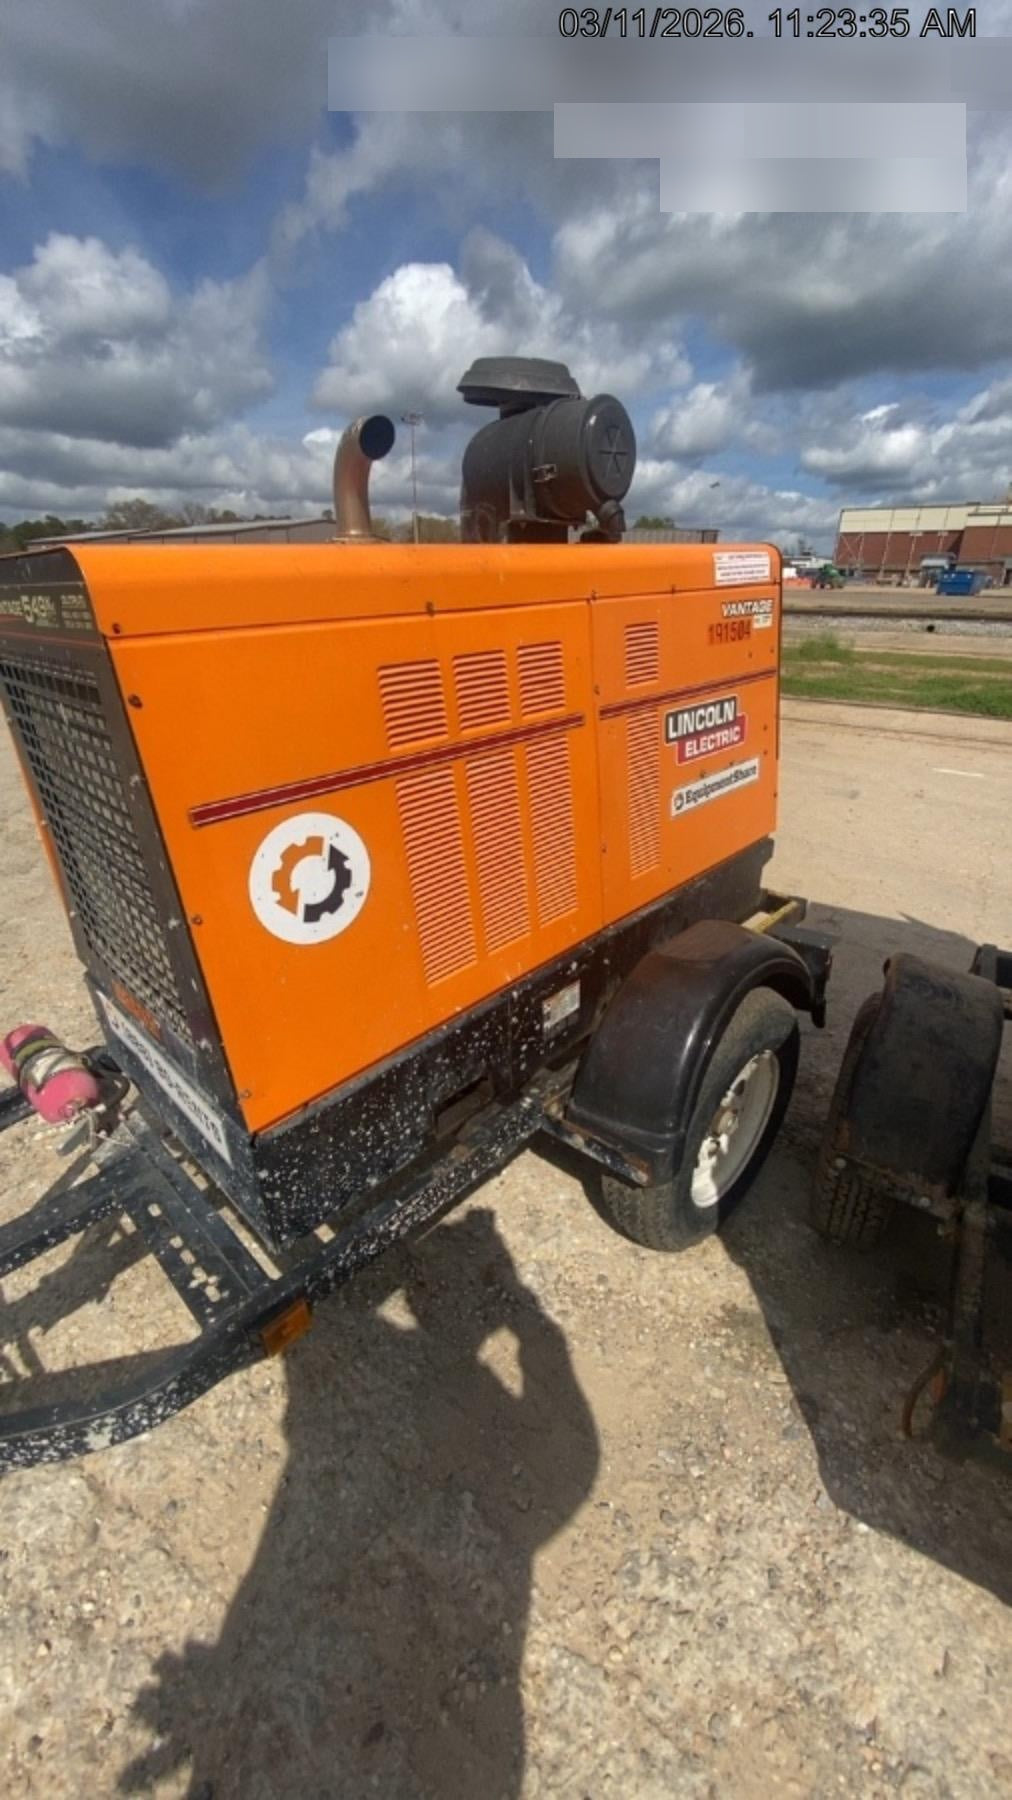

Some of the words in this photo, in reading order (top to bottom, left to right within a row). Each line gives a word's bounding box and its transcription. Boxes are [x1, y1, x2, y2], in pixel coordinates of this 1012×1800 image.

[721, 599, 774, 617] VANTAGE
[708, 619, 752, 644] 191504
[668, 700, 736, 740] LINCOLN
[684, 725, 741, 759] ELECTRIC
